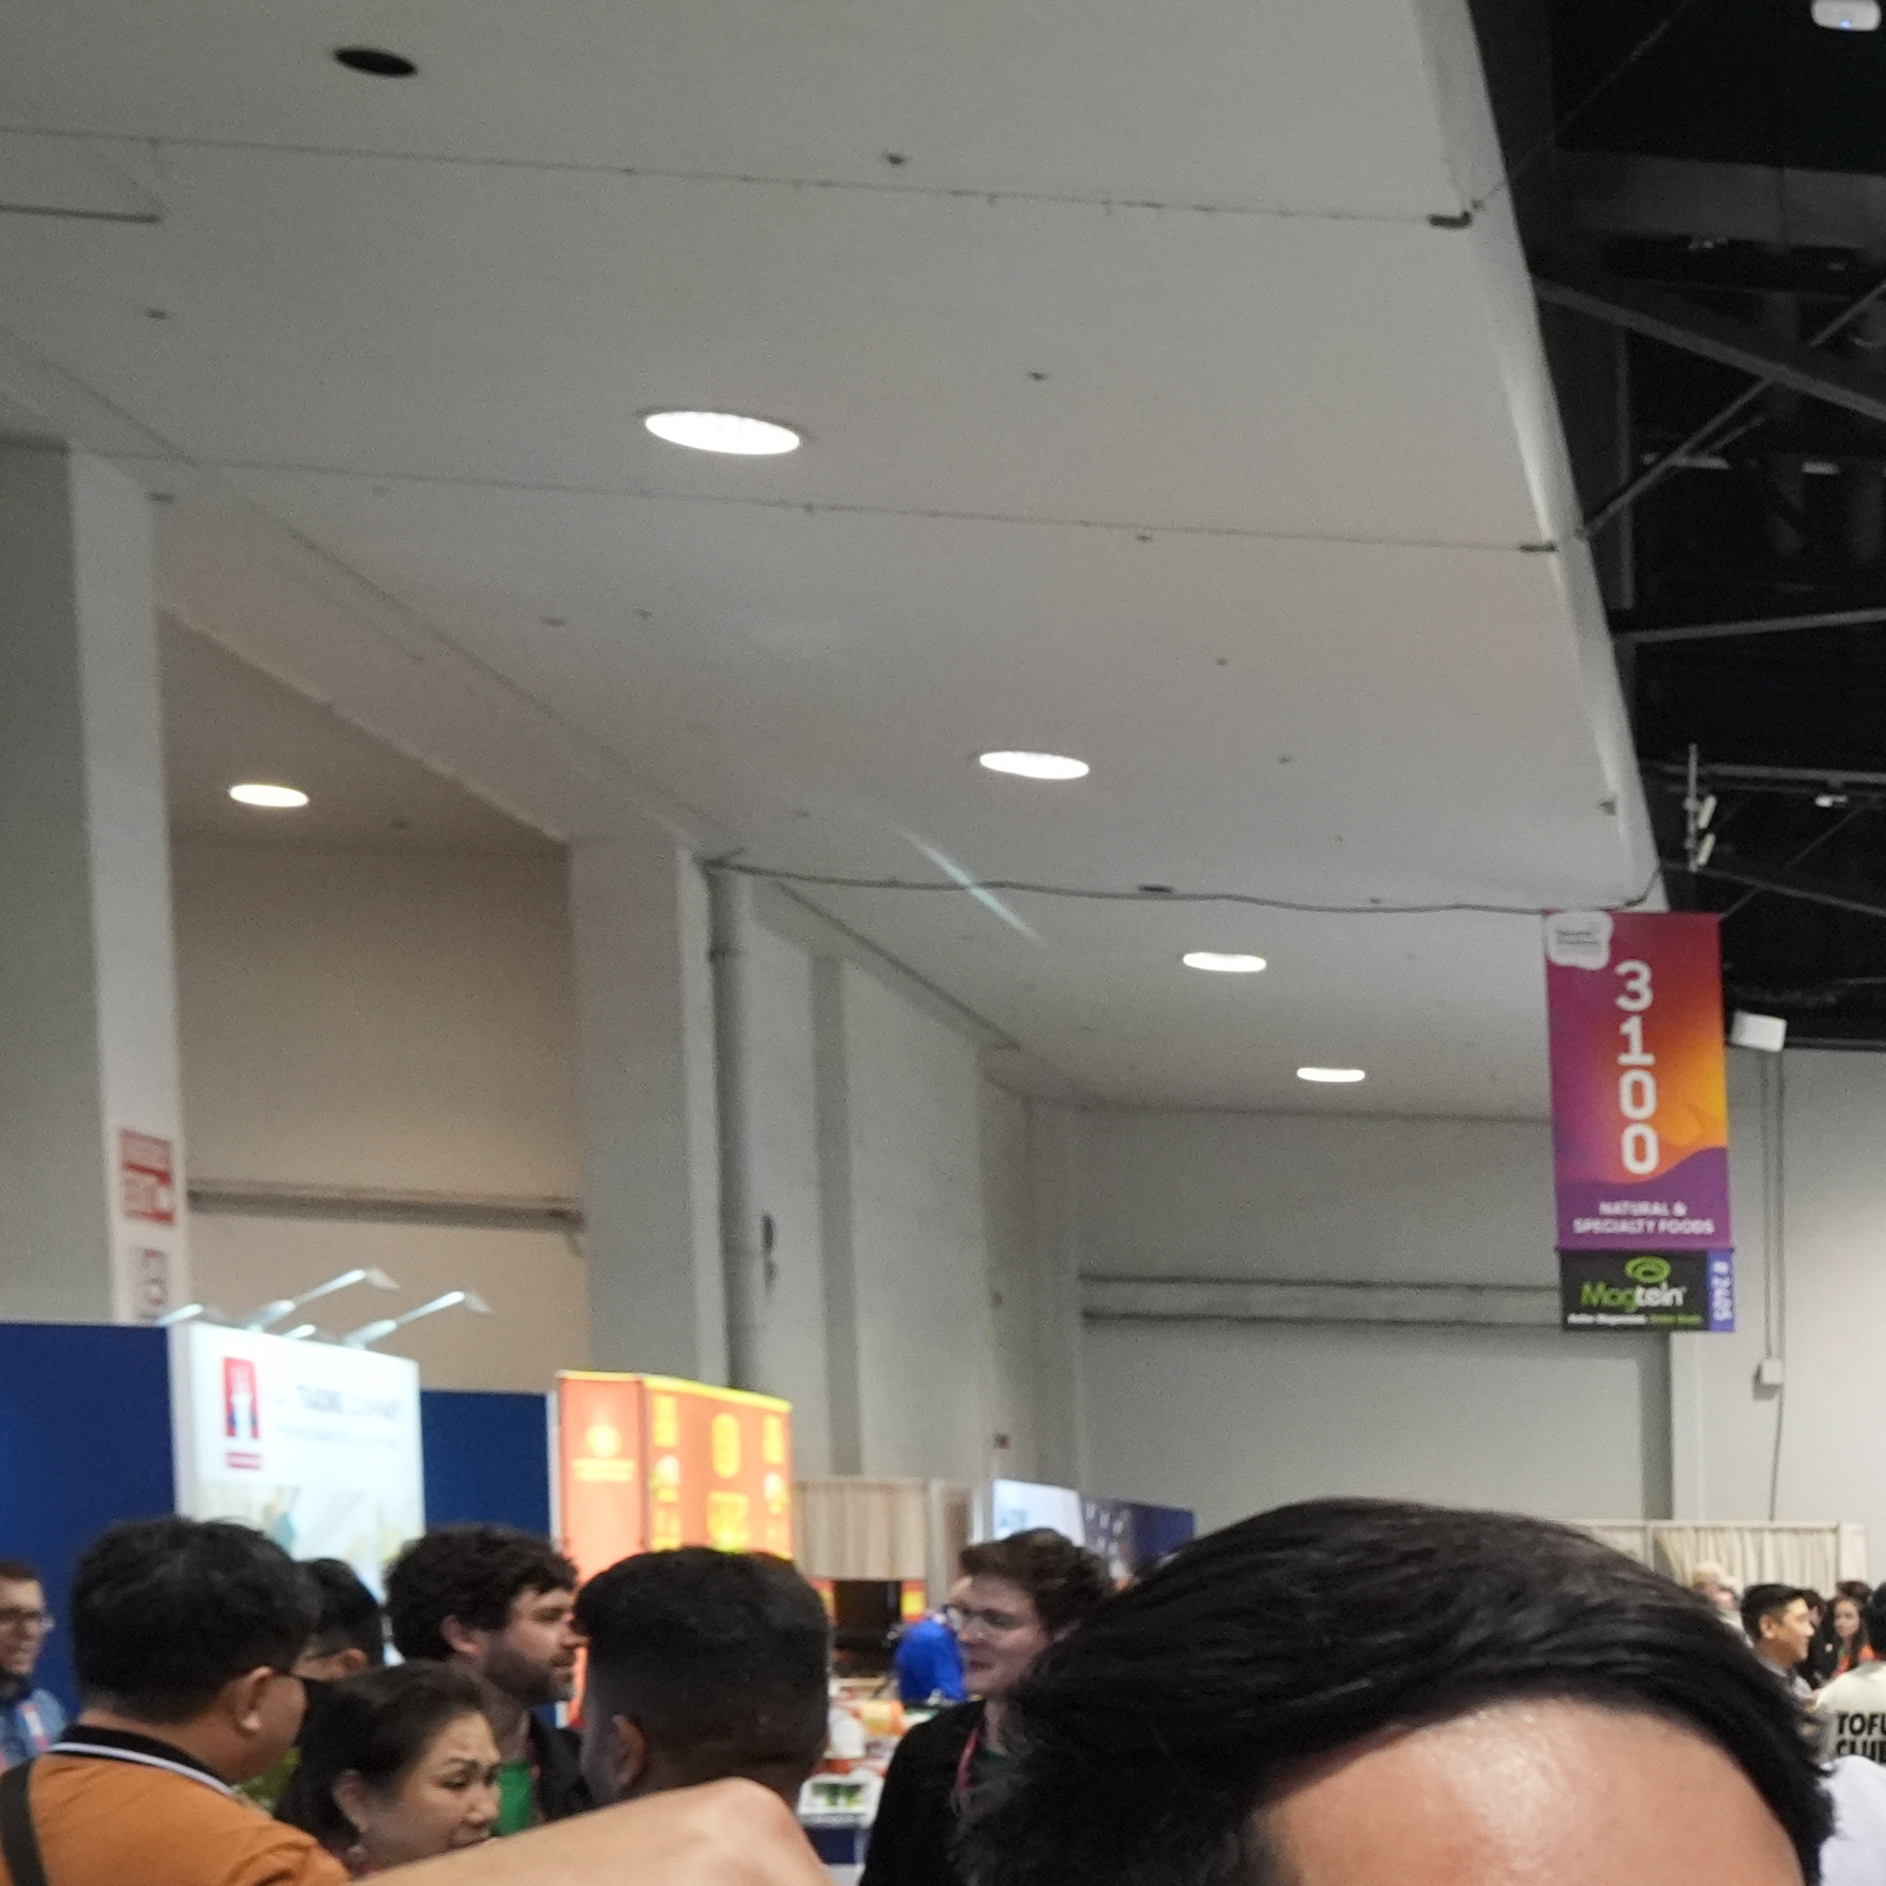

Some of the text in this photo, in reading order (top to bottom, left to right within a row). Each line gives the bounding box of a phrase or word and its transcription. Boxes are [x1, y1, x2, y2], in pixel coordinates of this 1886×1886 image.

[1599, 1200, 1670, 1217] NATURAL
[1573, 1218, 1715, 1235] SPECIALTY FOODS
